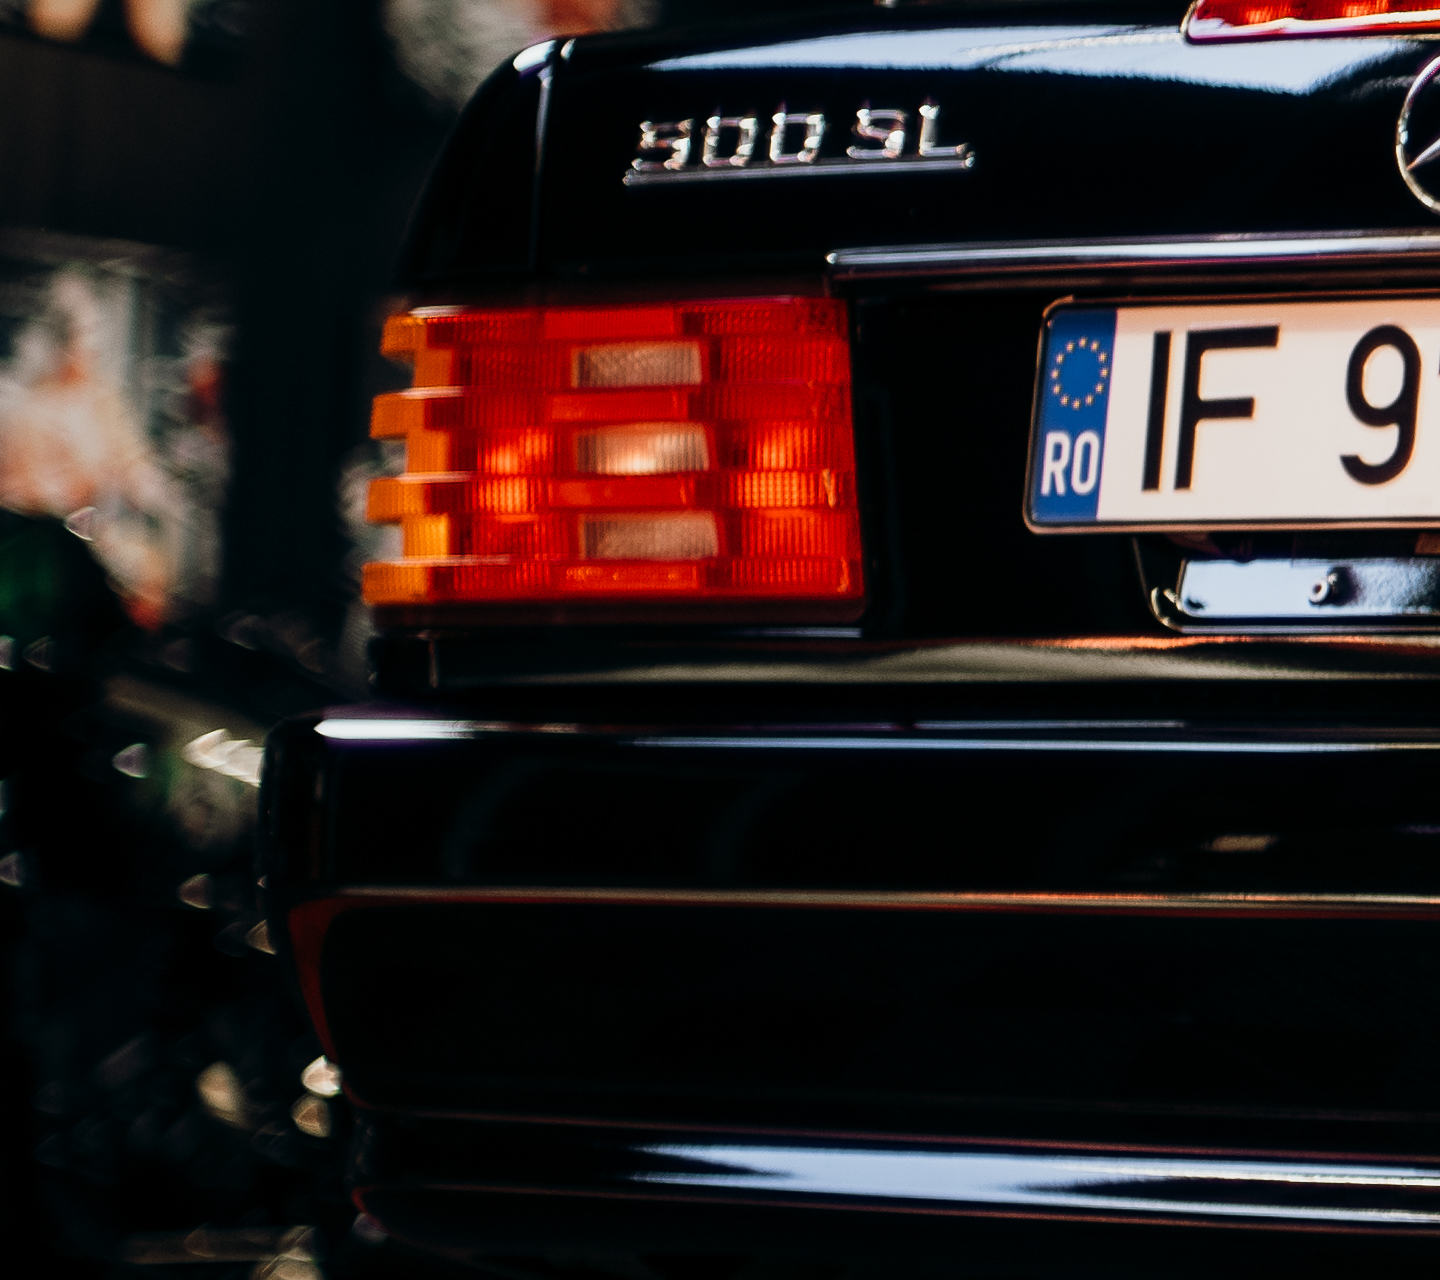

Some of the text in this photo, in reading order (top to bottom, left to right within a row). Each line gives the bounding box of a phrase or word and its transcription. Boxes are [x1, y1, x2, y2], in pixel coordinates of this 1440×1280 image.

[631, 104, 968, 170] 500 SL
[1141, 325, 1280, 491] IF
[1041, 431, 1099, 497] RO
